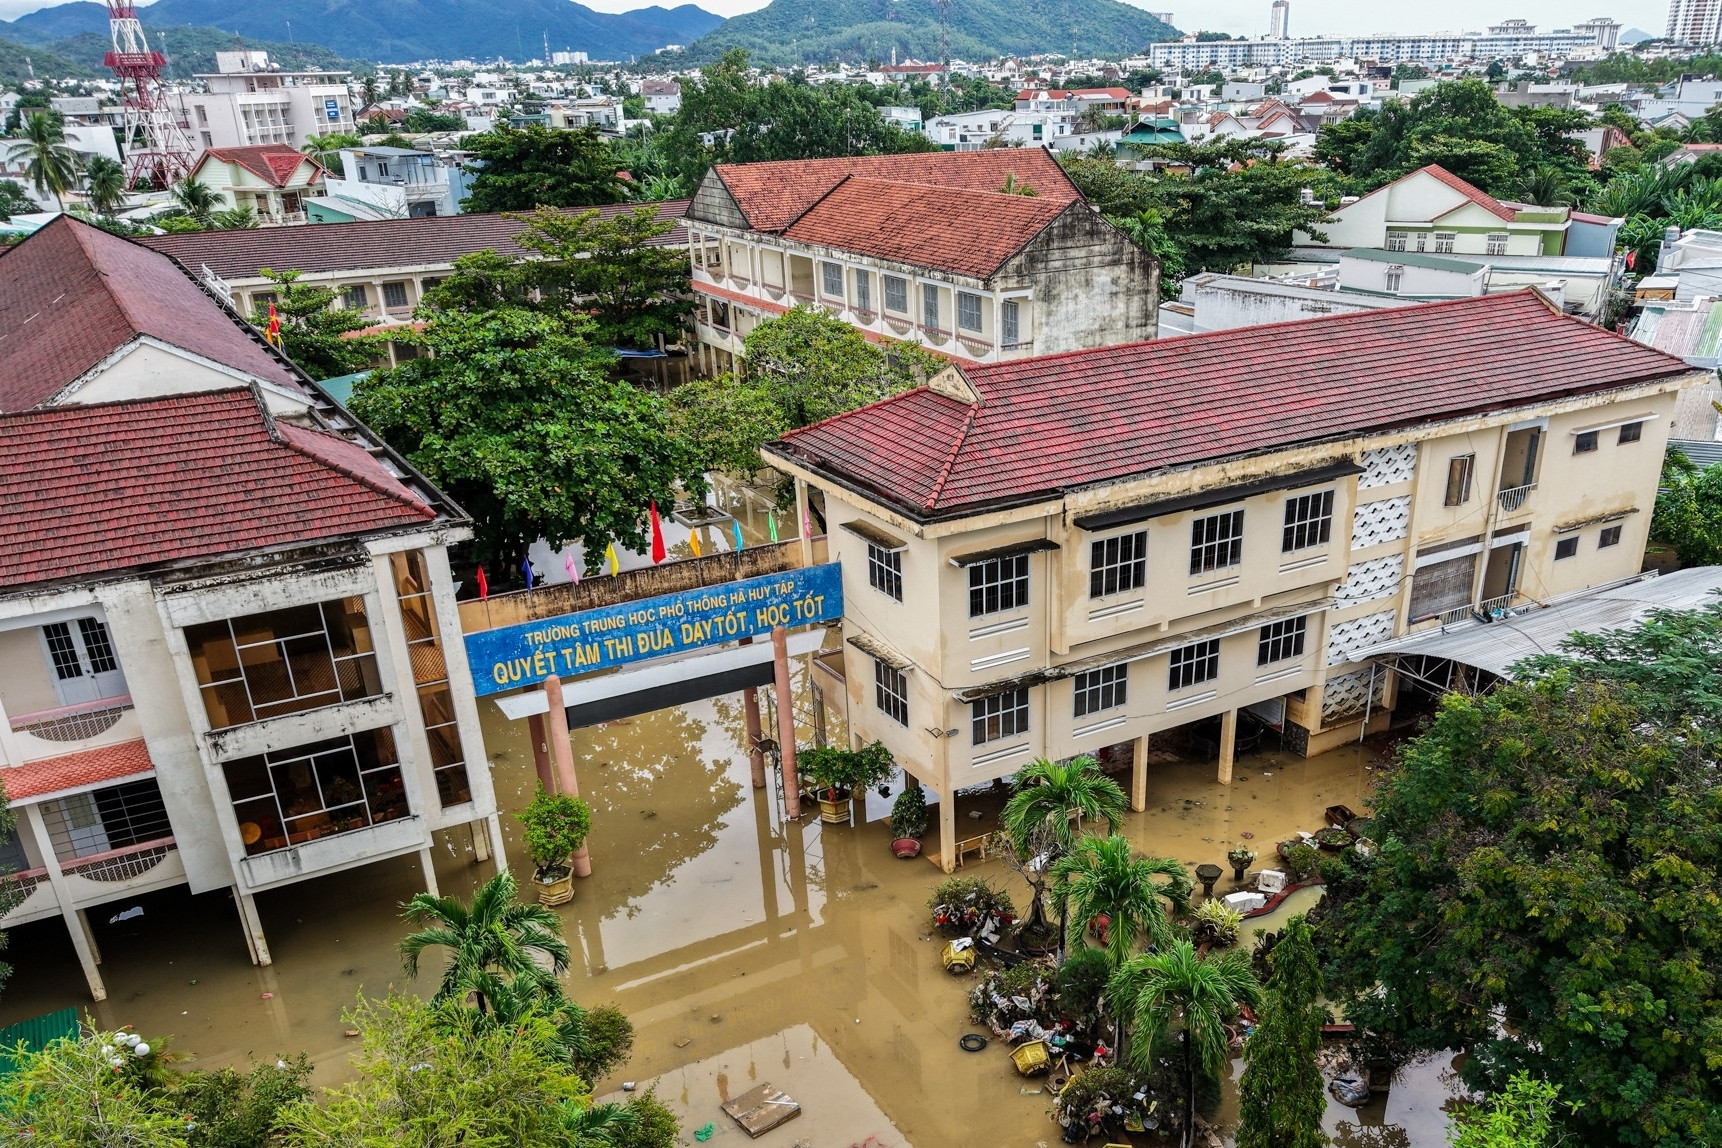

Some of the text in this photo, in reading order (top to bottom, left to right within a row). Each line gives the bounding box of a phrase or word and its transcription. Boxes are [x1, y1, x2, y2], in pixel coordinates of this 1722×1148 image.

[493, 645, 557, 684] QUYẾT
[561, 642, 601, 669] TÂM
[604, 636, 633, 660] THI
[637, 627, 674, 654] ĐUA
[757, 603, 790, 629] HỌC
[794, 591, 824, 620] TỐT
[525, 579, 795, 646] TRƯỜNG TRUNG HỌC PHỔ THÔNG HÀ HUY TẬP
